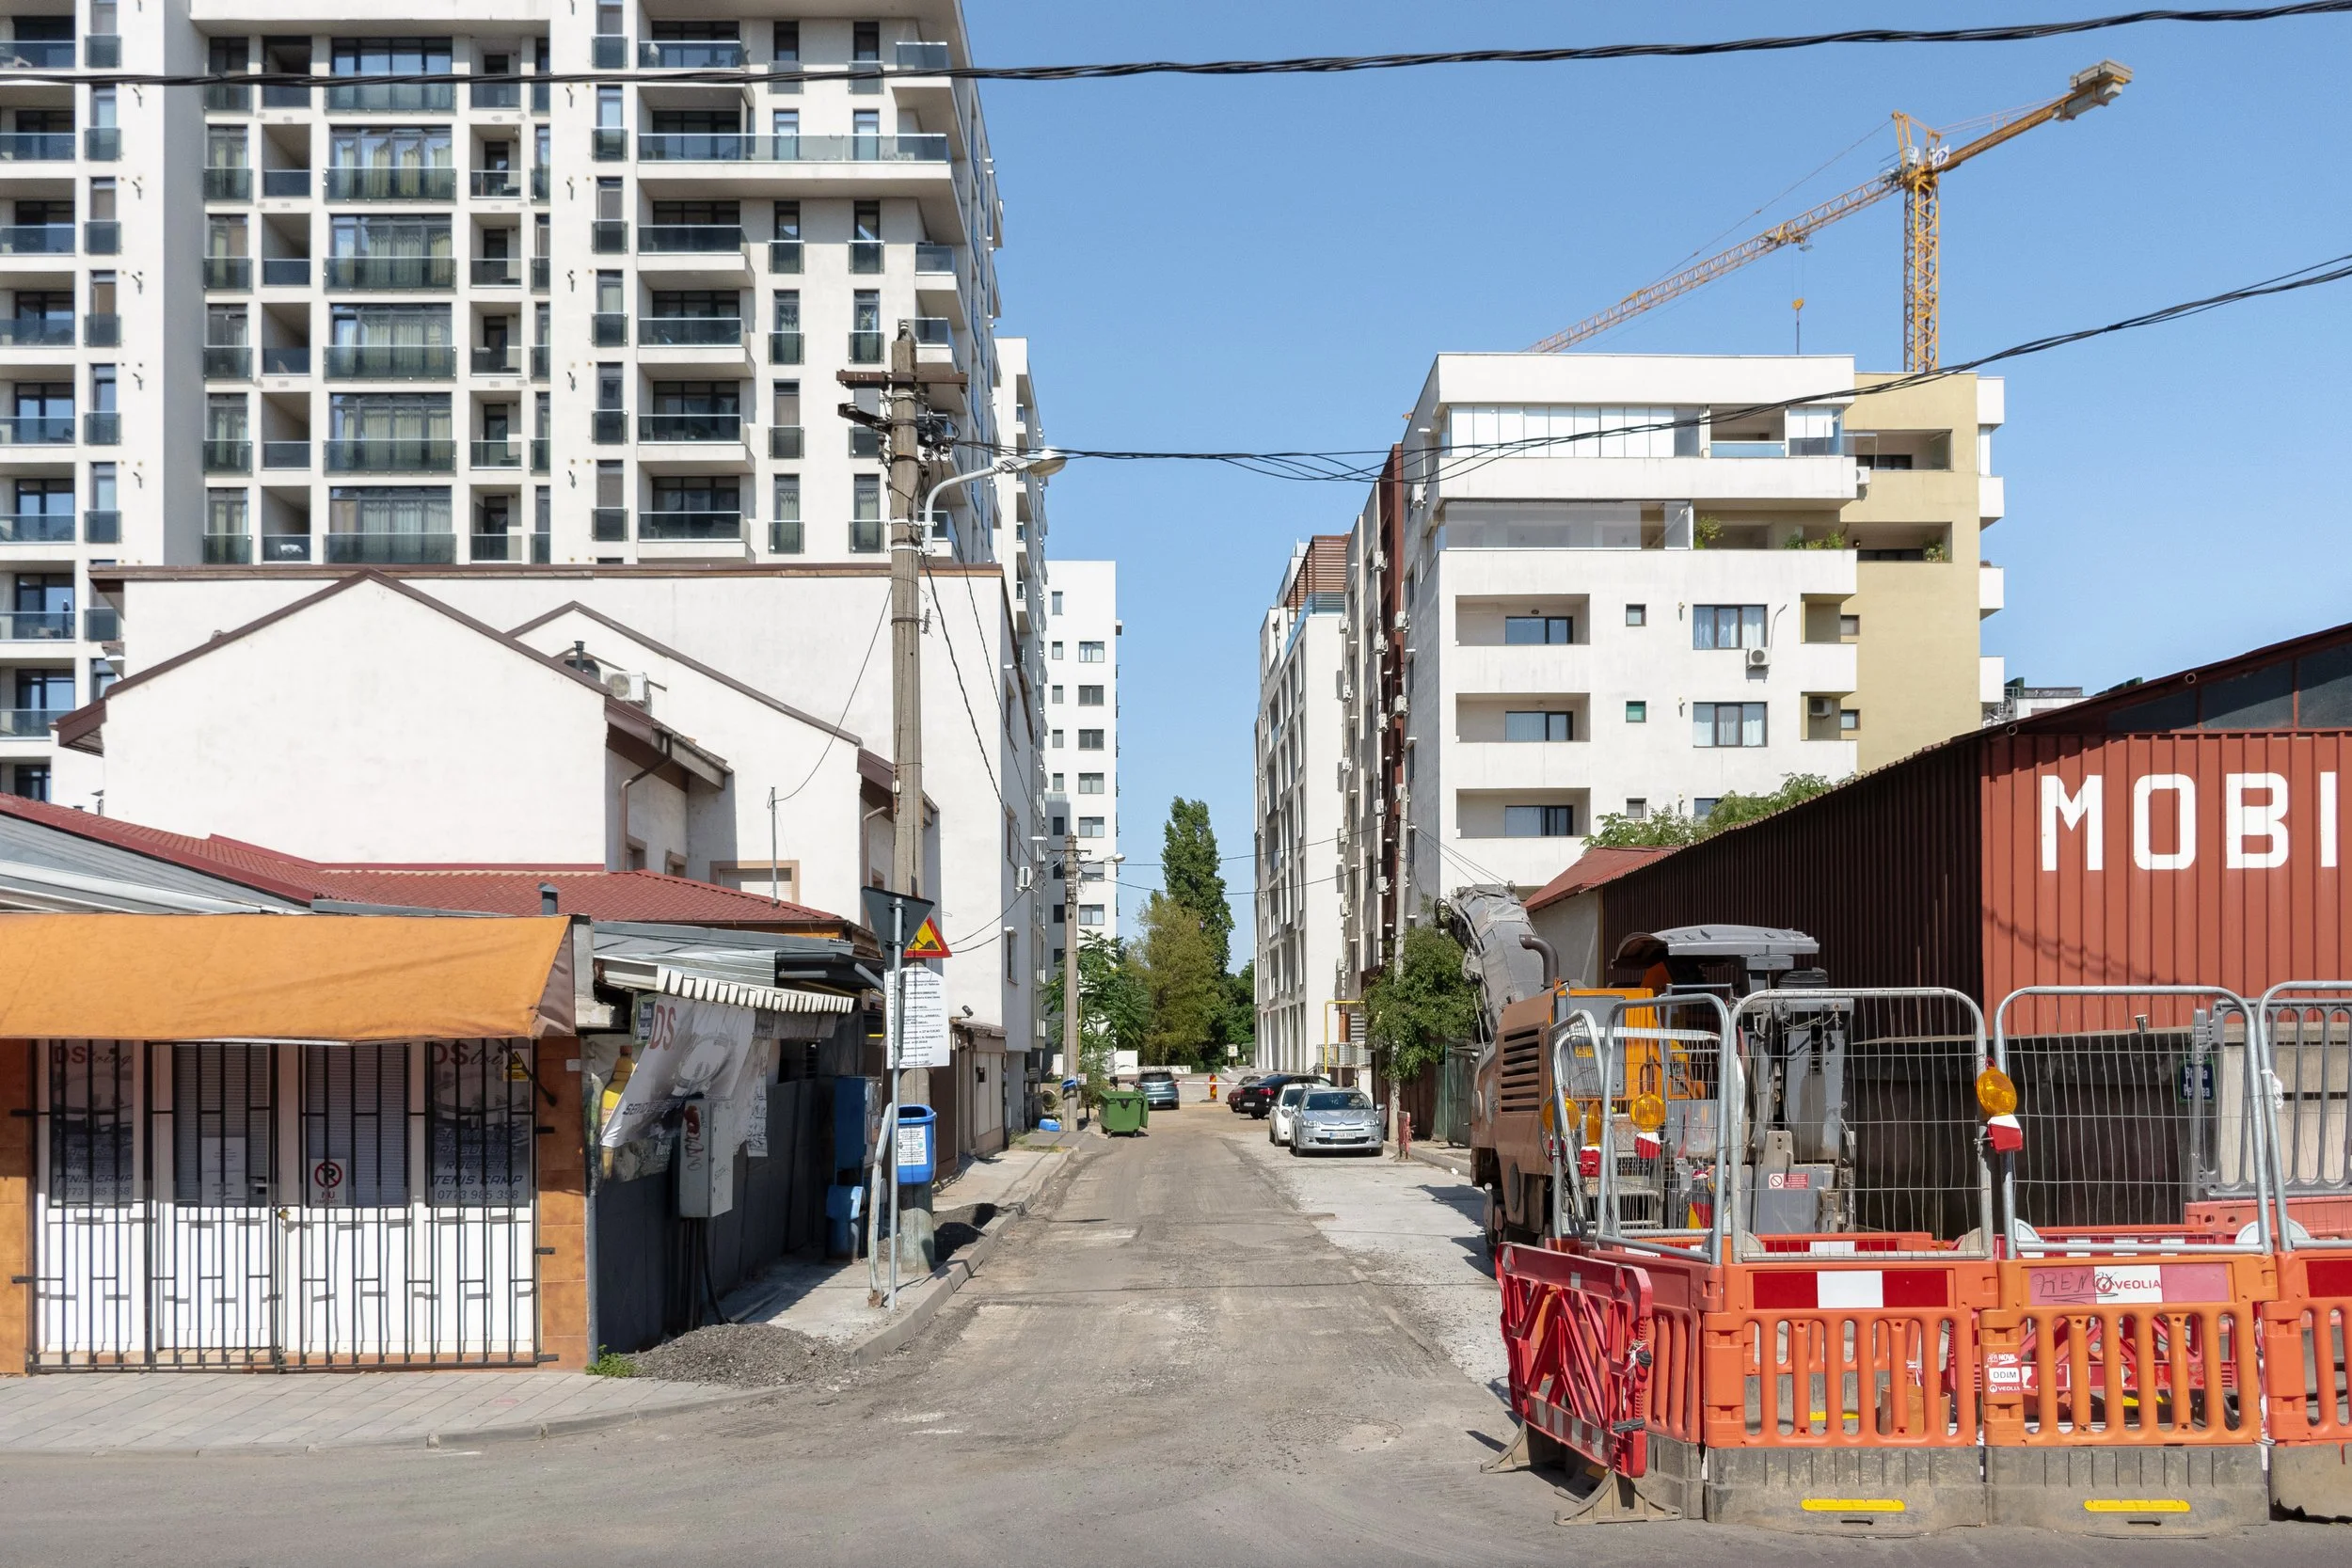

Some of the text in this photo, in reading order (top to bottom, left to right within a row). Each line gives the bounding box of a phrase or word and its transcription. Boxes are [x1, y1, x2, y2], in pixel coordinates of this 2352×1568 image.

[2042, 772, 2337, 871] MOBI
[433, 1175, 476, 1185] TENIS
[437, 1190, 467, 1199] 0773
[2116, 1279, 2161, 1291] VEOLIA
